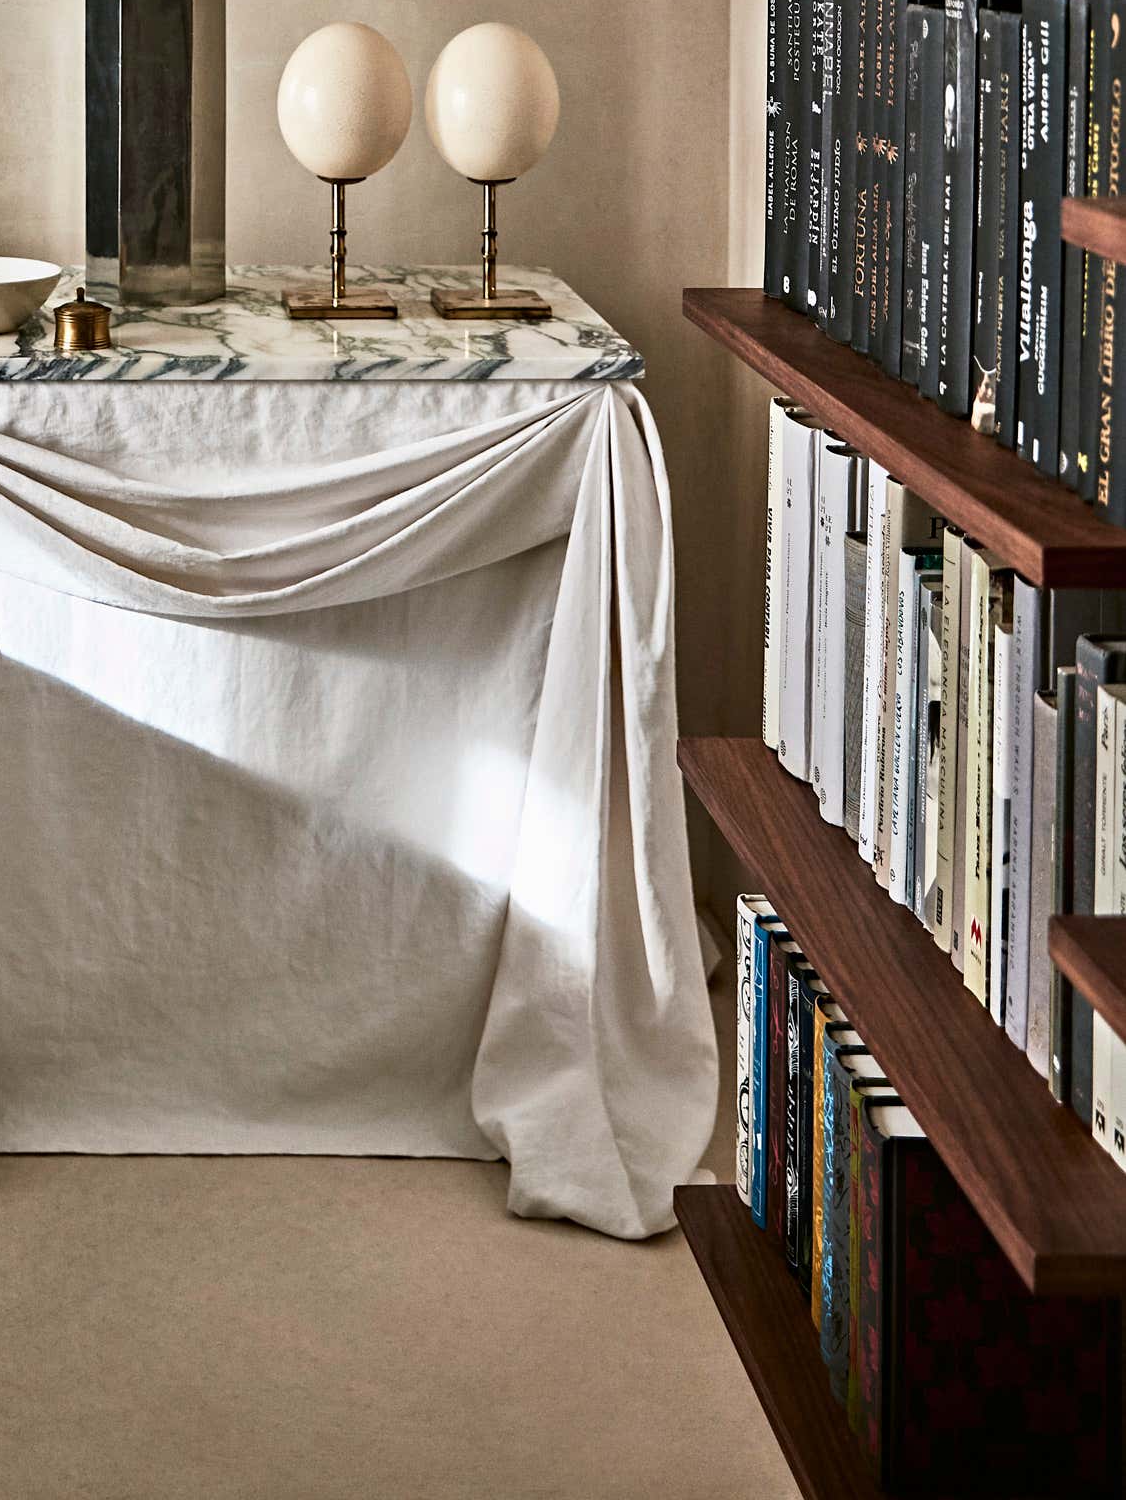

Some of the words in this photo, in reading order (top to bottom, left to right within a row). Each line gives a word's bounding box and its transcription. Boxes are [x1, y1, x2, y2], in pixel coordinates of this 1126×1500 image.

[769, 20, 775, 34] DE
[816, 2, 824, 56] KATE
[1040, 20, 1049, 66] Gill
[769, 70, 775, 83] LA
[857, 39, 865, 100] ISABEL
[874, 41, 882, 98] ISABEL
[887, 41, 895, 107] ISABEL
[1027, 102, 1035, 151] OTRA
[1040, 72, 1049, 143] Anton
[767, 130, 775, 180] ALLENDE
[790, 138, 798, 191] ROMA
[813, 150, 821, 171] EL
[833, 139, 841, 187] JUDÍO
[783, 215, 788, 235] LA
[789, 198, 796, 221] DE
[812, 178, 820, 245] JARDÍN
[831, 189, 840, 250] ÚLTIMO
[831, 255, 838, 274] EL
[854, 189, 867, 298] FORTUNA
[921, 240, 930, 275] Juan
[870, 265, 878, 297] DEL
[921, 277, 929, 323] Eslava
[941, 250, 949, 339] CATEDRAL
[1019, 199, 1038, 363] Vilallonga
[940, 344, 947, 366] LA
[1037, 285, 1048, 396] GUGGENHEIM
[1102, 304, 1115, 386] LIBRO
[1099, 391, 1112, 463] GRAN
[1097, 470, 1110, 506] EL
[944, 584, 950, 606] LA
[941, 616, 950, 718] ELEGANCIA
[1014, 664, 1022, 739] THROUGH
[939, 725, 947, 831] MASCULINA
